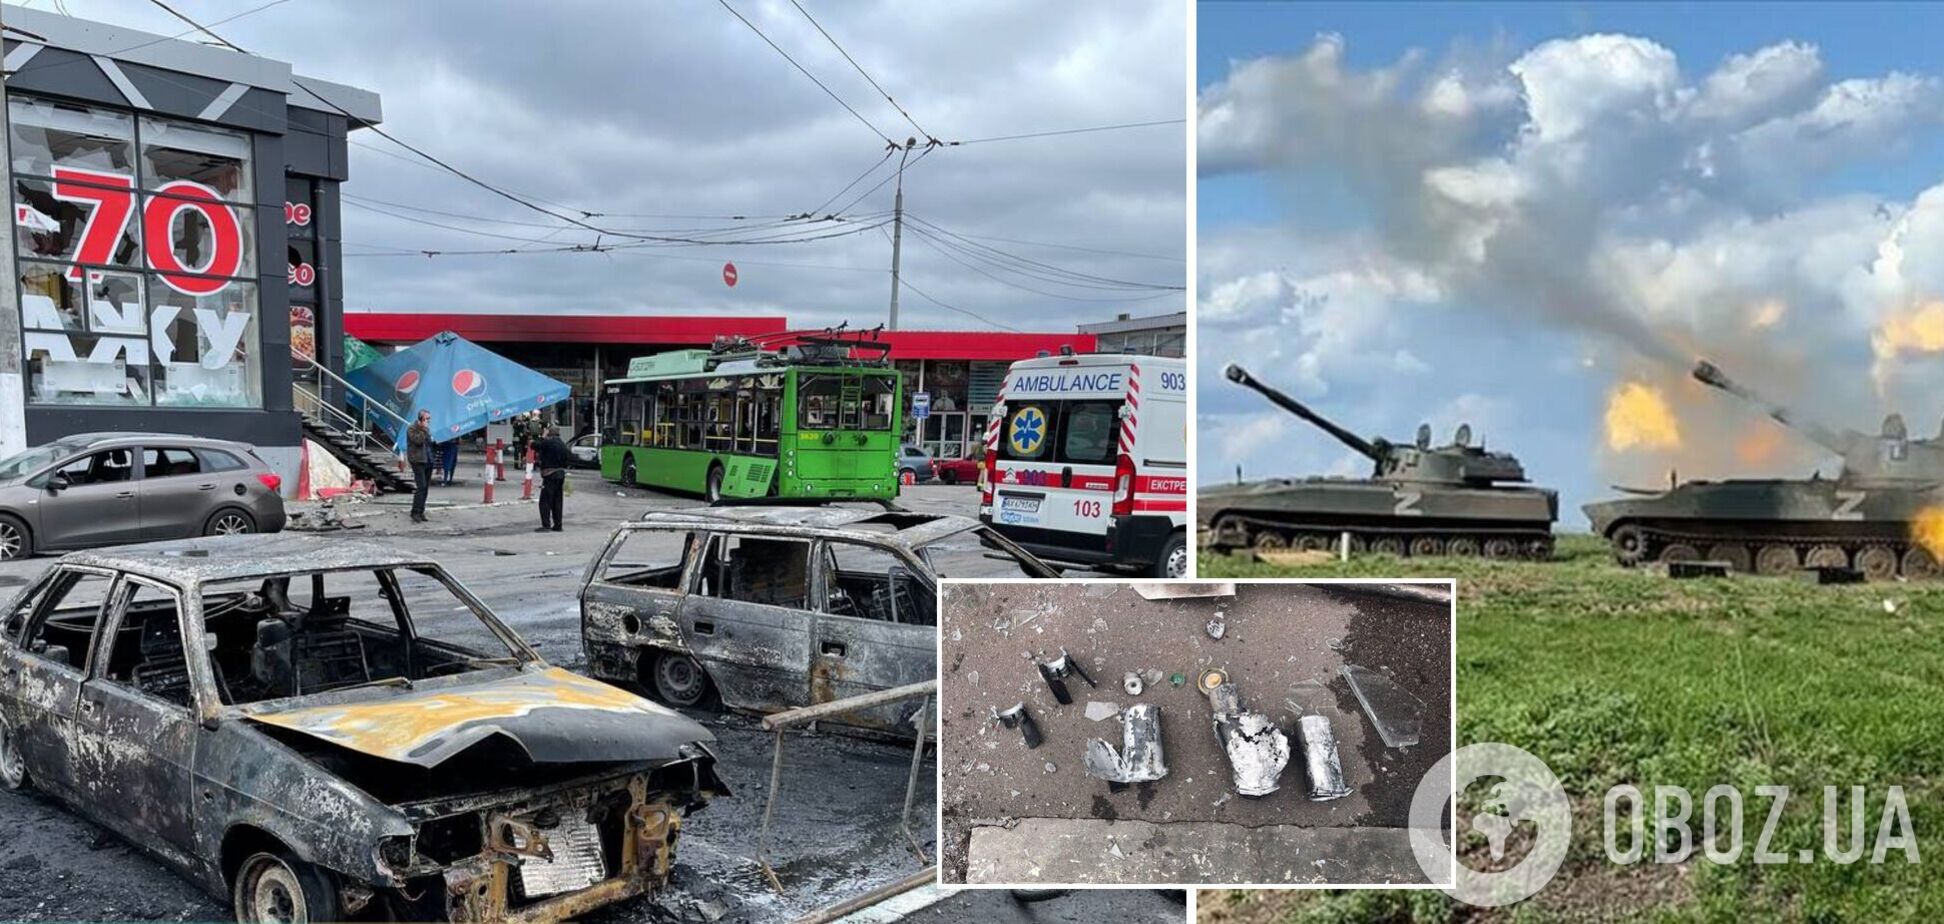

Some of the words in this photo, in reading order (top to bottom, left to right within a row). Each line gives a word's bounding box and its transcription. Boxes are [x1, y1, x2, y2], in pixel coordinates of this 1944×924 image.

[51, 165, 243, 296] 70
[1013, 373, 1122, 392] AMBULANCE
[1161, 372, 1186, 390] 903
[1074, 500, 1101, 518] 103
[1393, 491, 1422, 515] Z
[1832, 491, 1866, 520] Z
